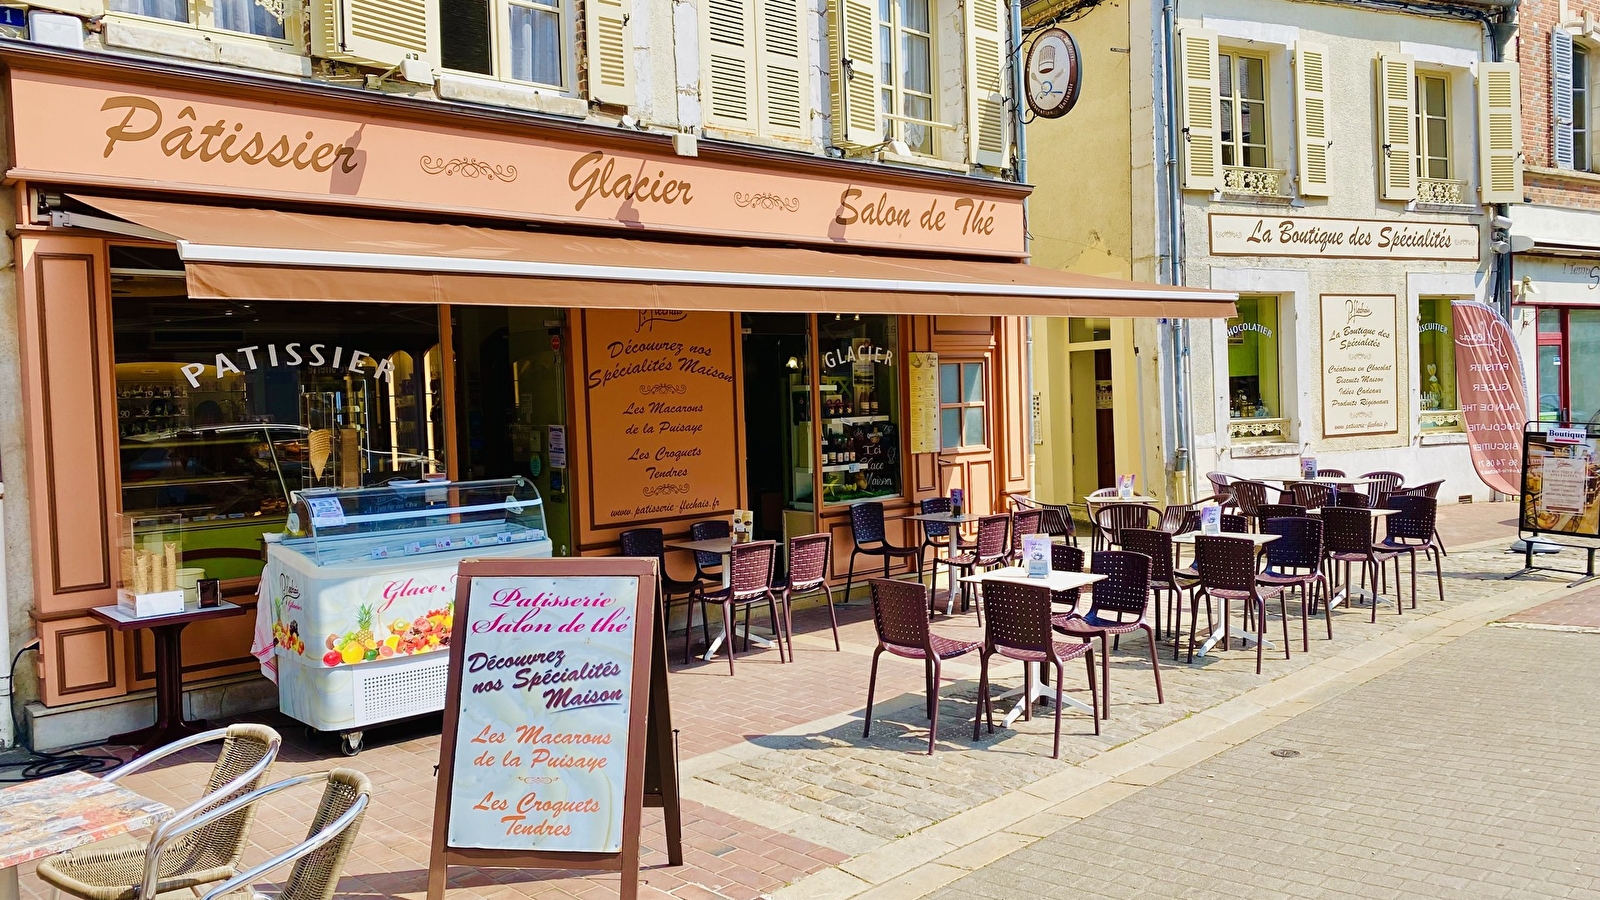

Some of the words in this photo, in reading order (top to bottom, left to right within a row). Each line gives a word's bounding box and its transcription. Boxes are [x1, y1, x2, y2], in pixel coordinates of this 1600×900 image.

[100, 95, 360, 175] Pâtissier
[568, 150, 694, 212] Glacier
[835, 188, 911, 229] Salon
[920, 199, 946, 231] de
[954, 198, 995, 236] Thé
[1246, 219, 1272, 244] La
[1278, 220, 1343, 252] Boutique
[1348, 225, 1372, 246] des
[1378, 226, 1452, 252] Spécialités
[1227, 322, 1273, 338] HOCOLATIER
[1328, 330, 1340, 341] La
[1343, 326, 1376, 338] Boutique
[1378, 329, 1390, 339] des
[1419, 322, 1449, 334] ISCUITIER
[607, 339, 684, 358] Découvrez
[689, 346, 712, 356] nos
[1340, 338, 1381, 350] Spécialités
[181, 342, 396, 388] PATISSIER
[824, 345, 893, 368] GLACIER
[588, 356, 673, 390] Spécialités
[677, 357, 734, 383] Maison
[622, 402, 645, 414] Les
[648, 402, 704, 414] Macarons
[626, 424, 639, 434] de
[642, 423, 655, 434] la
[658, 422, 703, 434] Puisaye
[1548, 429, 1585, 440] Boutique
[628, 448, 650, 460] Les
[654, 446, 702, 461] Croquets
[646, 467, 688, 480] Tendres
[377, 578, 438, 614] Glace
[489, 586, 616, 608] Patisserie
[471, 607, 551, 636] Salon
[558, 612, 586, 633] de
[590, 606, 631, 633] thé
[468, 649, 566, 673] Découvrez
[472, 679, 504, 694] nos
[512, 662, 621, 692] Spécialités
[542, 688, 622, 710] Maison
[470, 724, 506, 744] Les
[516, 724, 612, 745] Macarons
[474, 750, 496, 768] de
[502, 750, 522, 768] la
[530, 748, 608, 773] Puisaye
[472, 791, 508, 811] Les
[516, 792, 600, 818] Croquets
[500, 815, 572, 836] Tendres
